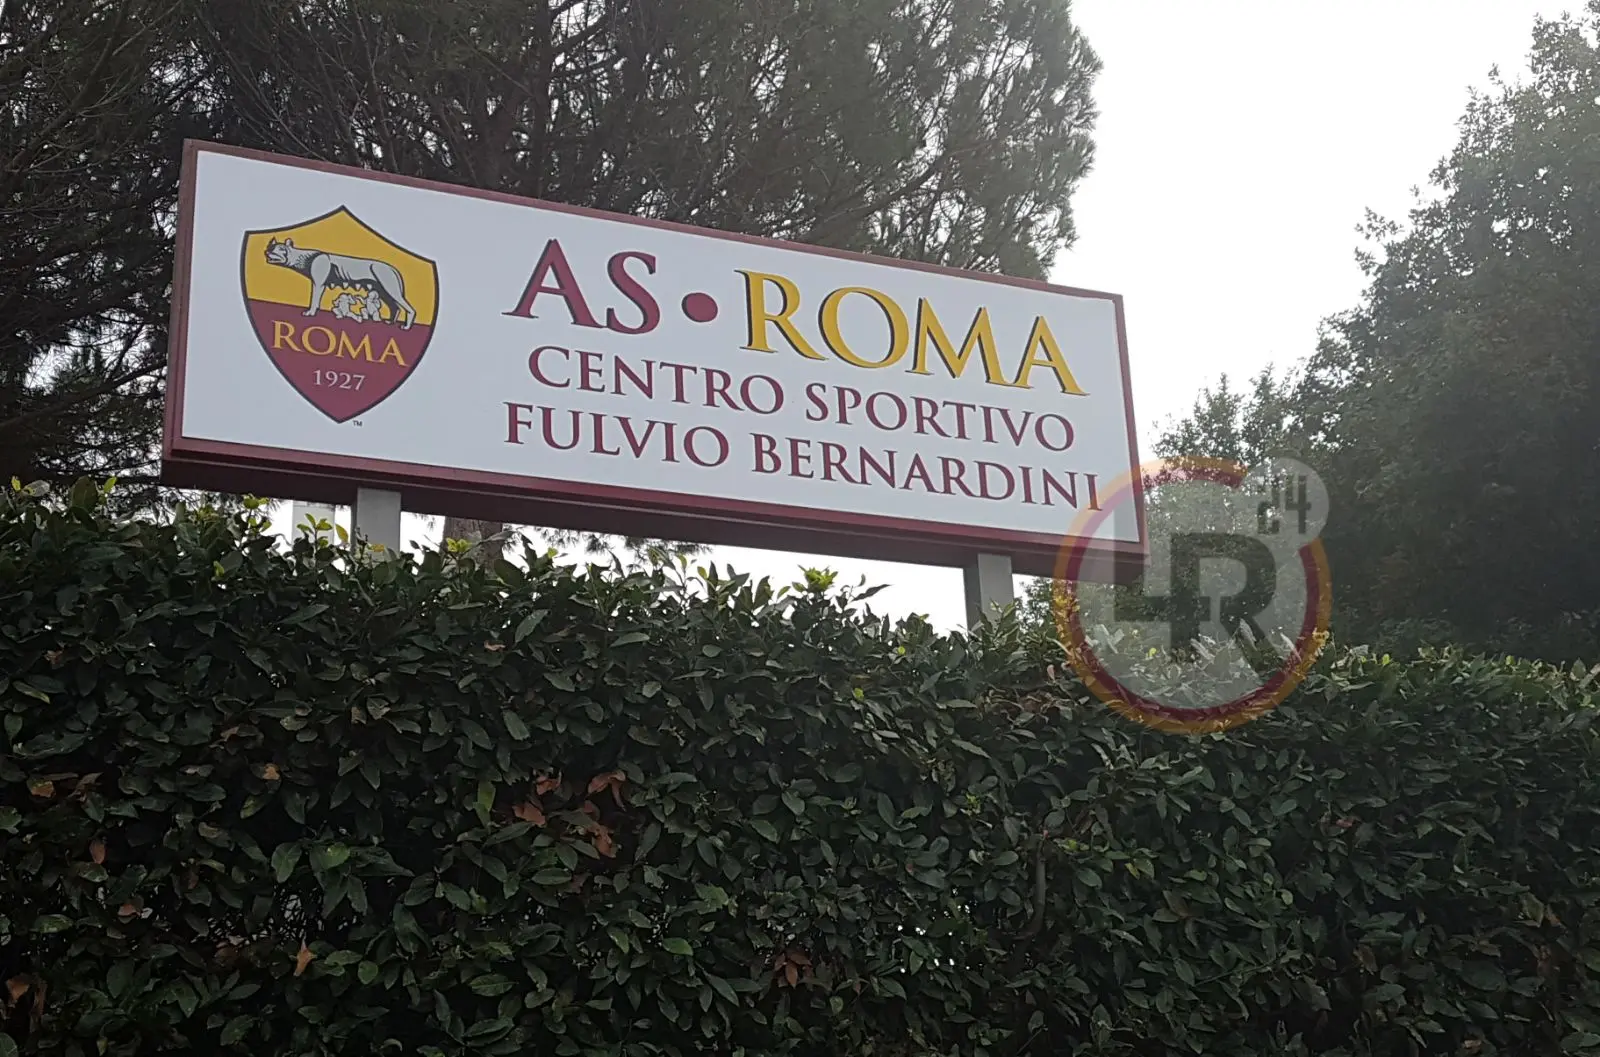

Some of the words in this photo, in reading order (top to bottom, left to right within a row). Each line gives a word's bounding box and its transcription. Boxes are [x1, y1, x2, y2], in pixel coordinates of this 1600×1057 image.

[271, 320, 409, 367] ROMA
[502, 238, 661, 335] AS
[733, 268, 1091, 397] ROMA
[313, 369, 366, 391] 1927
[528, 345, 784, 414] CENTRO
[805, 382, 1075, 451] SPORTIVO
[503, 401, 730, 467] FULVIO
[749, 432, 1103, 511] BERNARDINI
